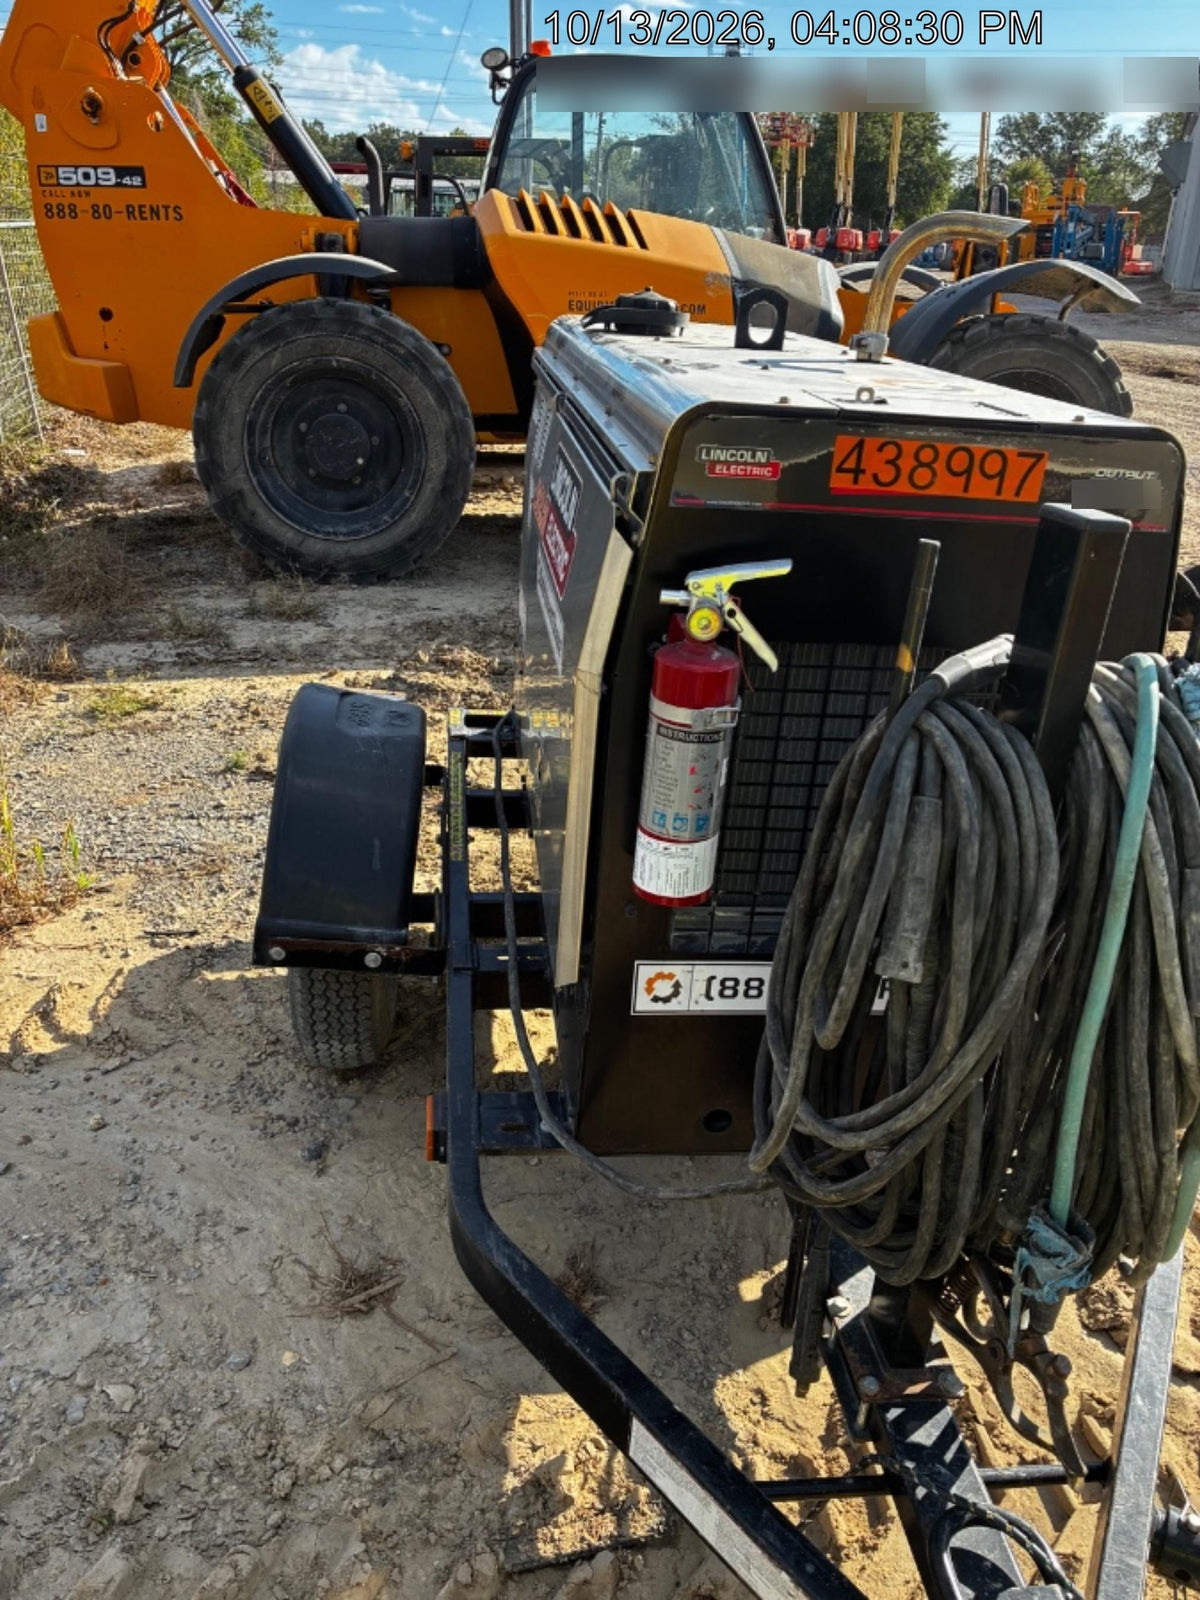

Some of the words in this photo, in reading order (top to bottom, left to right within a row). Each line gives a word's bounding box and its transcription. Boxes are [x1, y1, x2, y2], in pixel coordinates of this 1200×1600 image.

[41, 189, 66, 198] CALL
[43, 202, 184, 222] 888-80-RENTS
[701, 447, 769, 464] LINCOLN
[715, 463, 773, 477] ELECTRIC
[834, 436, 1047, 499] 438997
[1094, 467, 1159, 481] OUTPUT
